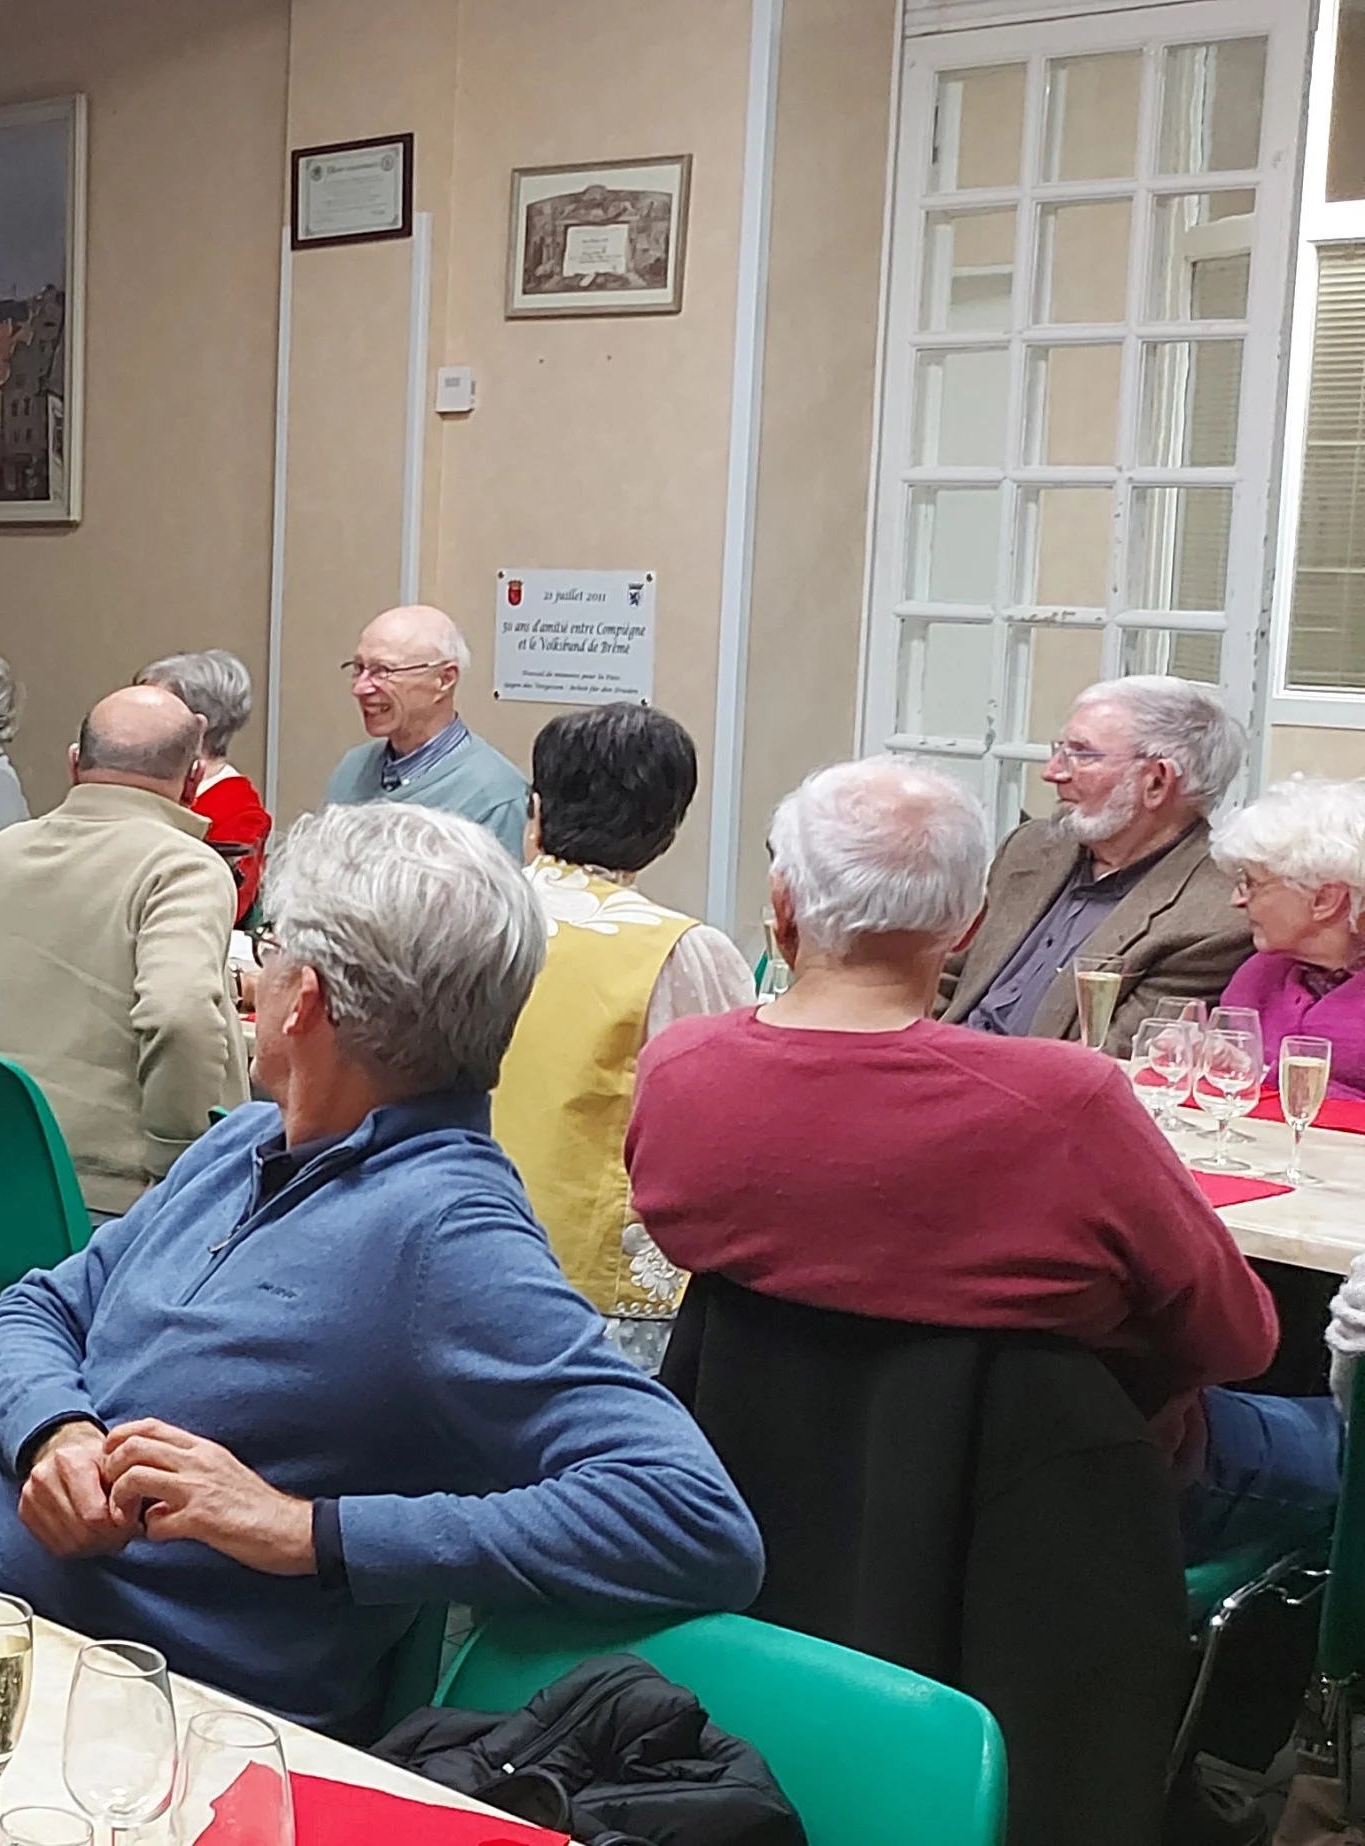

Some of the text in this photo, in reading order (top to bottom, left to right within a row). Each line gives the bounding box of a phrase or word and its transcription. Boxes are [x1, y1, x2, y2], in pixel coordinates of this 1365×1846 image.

[553, 588, 583, 604] juillet
[586, 592, 606, 602] 2011
[514, 622, 529, 633] ans
[570, 622, 594, 635] entre
[518, 638, 527, 650] et
[529, 636, 536, 650] le
[540, 637, 586, 652] Volksbund
[587, 639, 599, 653] de
